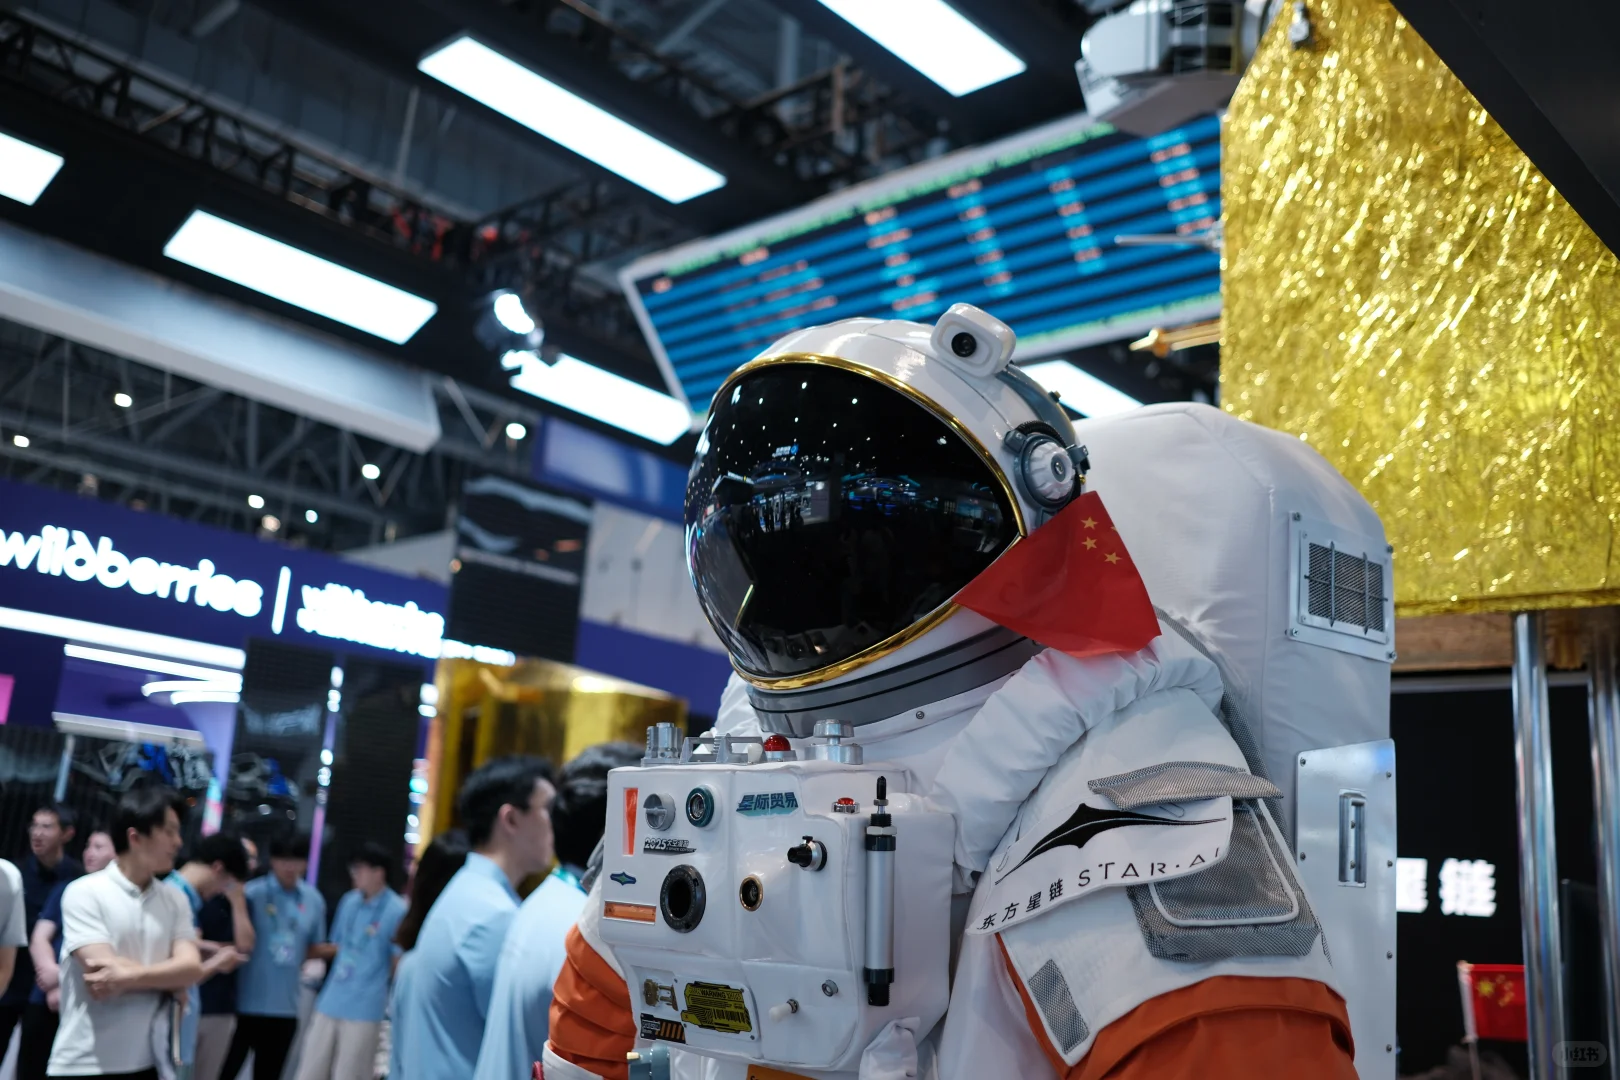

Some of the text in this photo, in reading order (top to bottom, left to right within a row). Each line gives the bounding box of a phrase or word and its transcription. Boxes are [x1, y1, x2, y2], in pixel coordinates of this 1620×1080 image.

[0, 525, 263, 617] wildberries
[736, 792, 798, 811] 星际贸易
[977, 878, 1064, 930] 东方星链
[701, 989, 727, 999] WARNING
